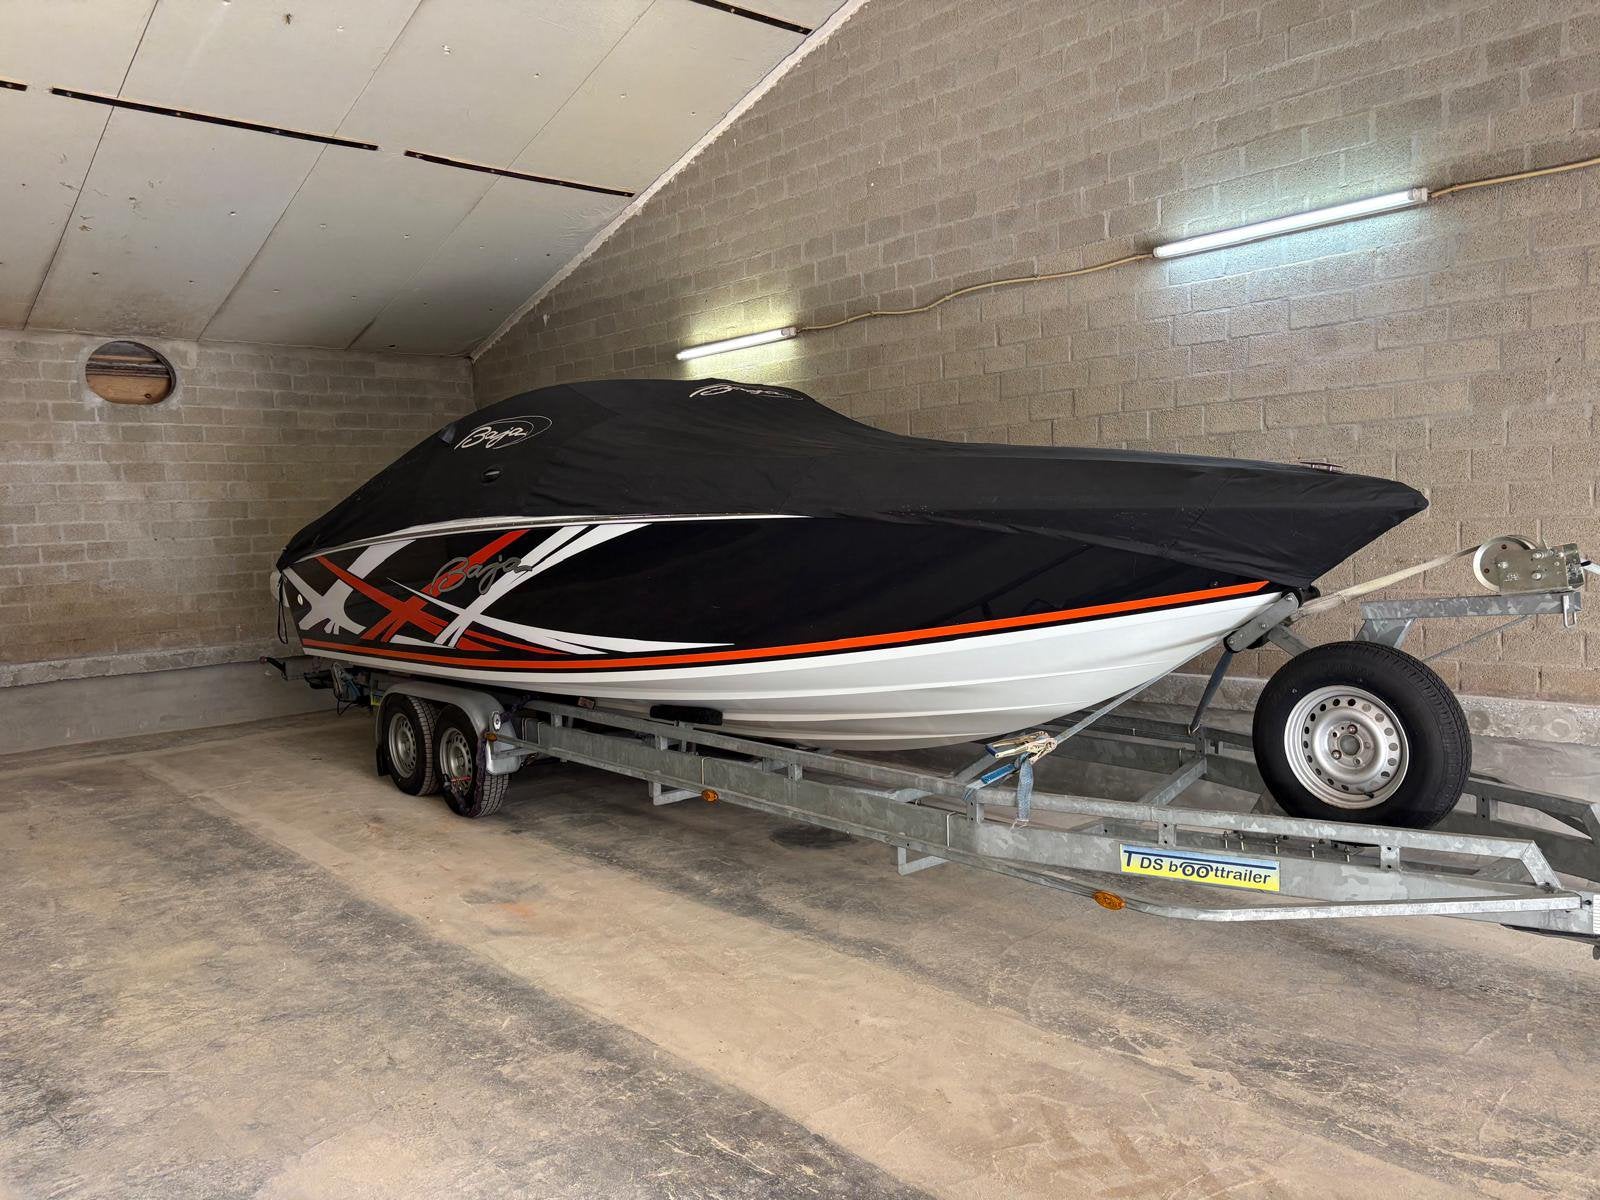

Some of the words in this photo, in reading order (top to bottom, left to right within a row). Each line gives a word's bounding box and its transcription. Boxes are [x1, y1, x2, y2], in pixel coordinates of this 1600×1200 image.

[454, 426, 527, 450] Baja
[430, 555, 533, 595] Baja
[1169, 861, 1271, 884] boottrailer
